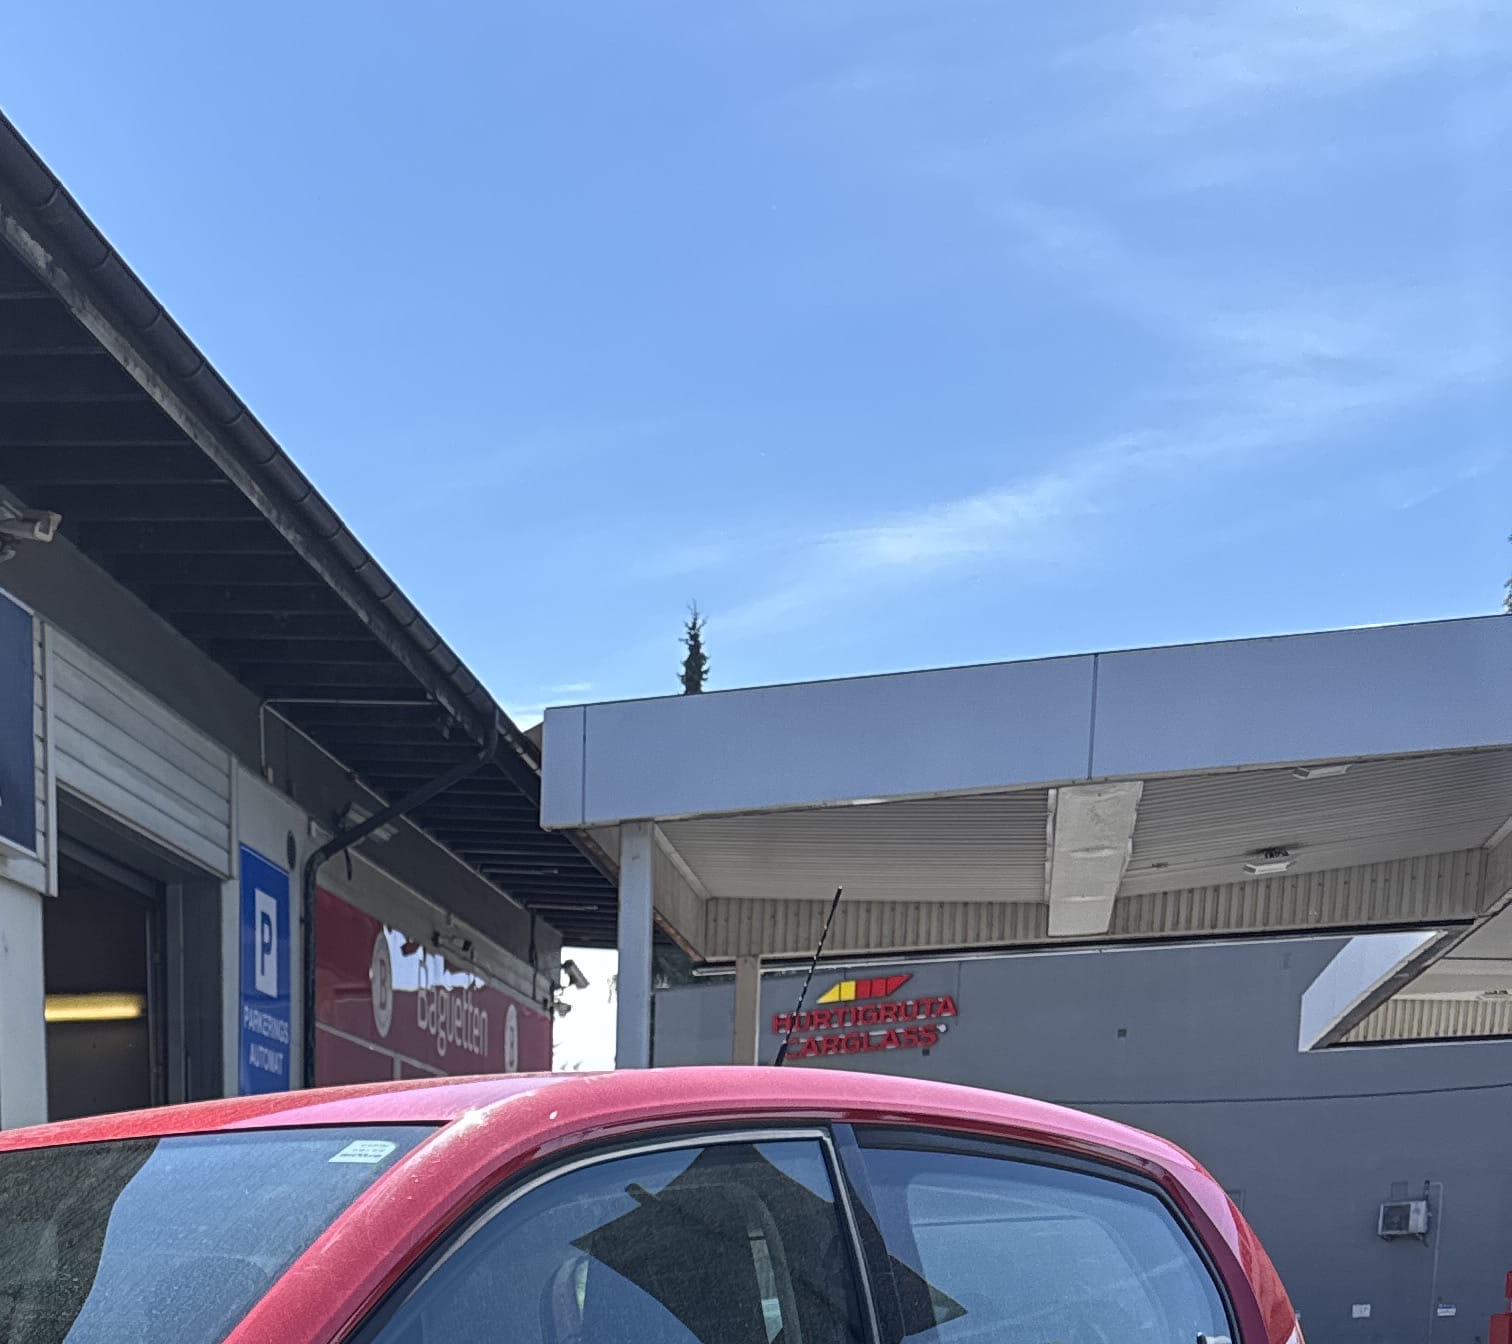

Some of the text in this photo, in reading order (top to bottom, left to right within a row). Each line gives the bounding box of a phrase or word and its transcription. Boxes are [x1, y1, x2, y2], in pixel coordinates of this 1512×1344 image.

[260, 910, 273, 977] P
[244, 1005, 289, 1045] PARKERINGS
[772, 995, 958, 1034] HURTIGRUTA
[249, 1043, 284, 1075] AUTOMAT
